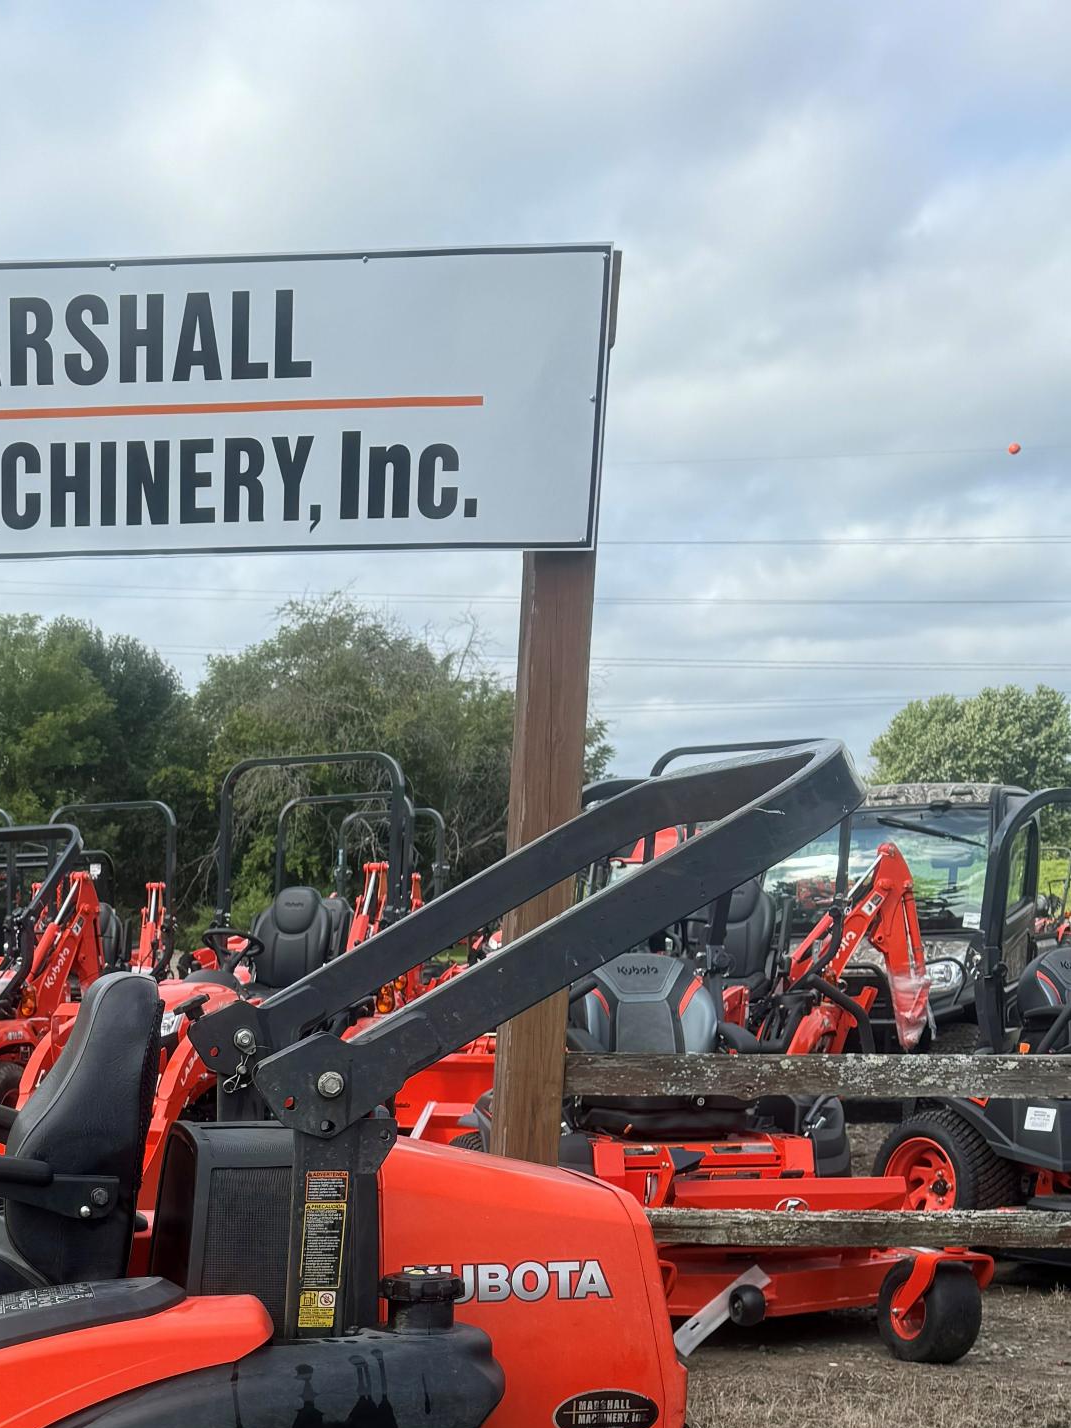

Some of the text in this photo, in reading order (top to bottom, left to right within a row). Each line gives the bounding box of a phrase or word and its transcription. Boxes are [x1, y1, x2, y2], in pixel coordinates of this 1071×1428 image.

[339, 430, 478, 519] Inc.
[44, 947, 70, 989] Kubota
[617, 965, 659, 976] Kubota
[402, 1260, 613, 1304] UBOTA
